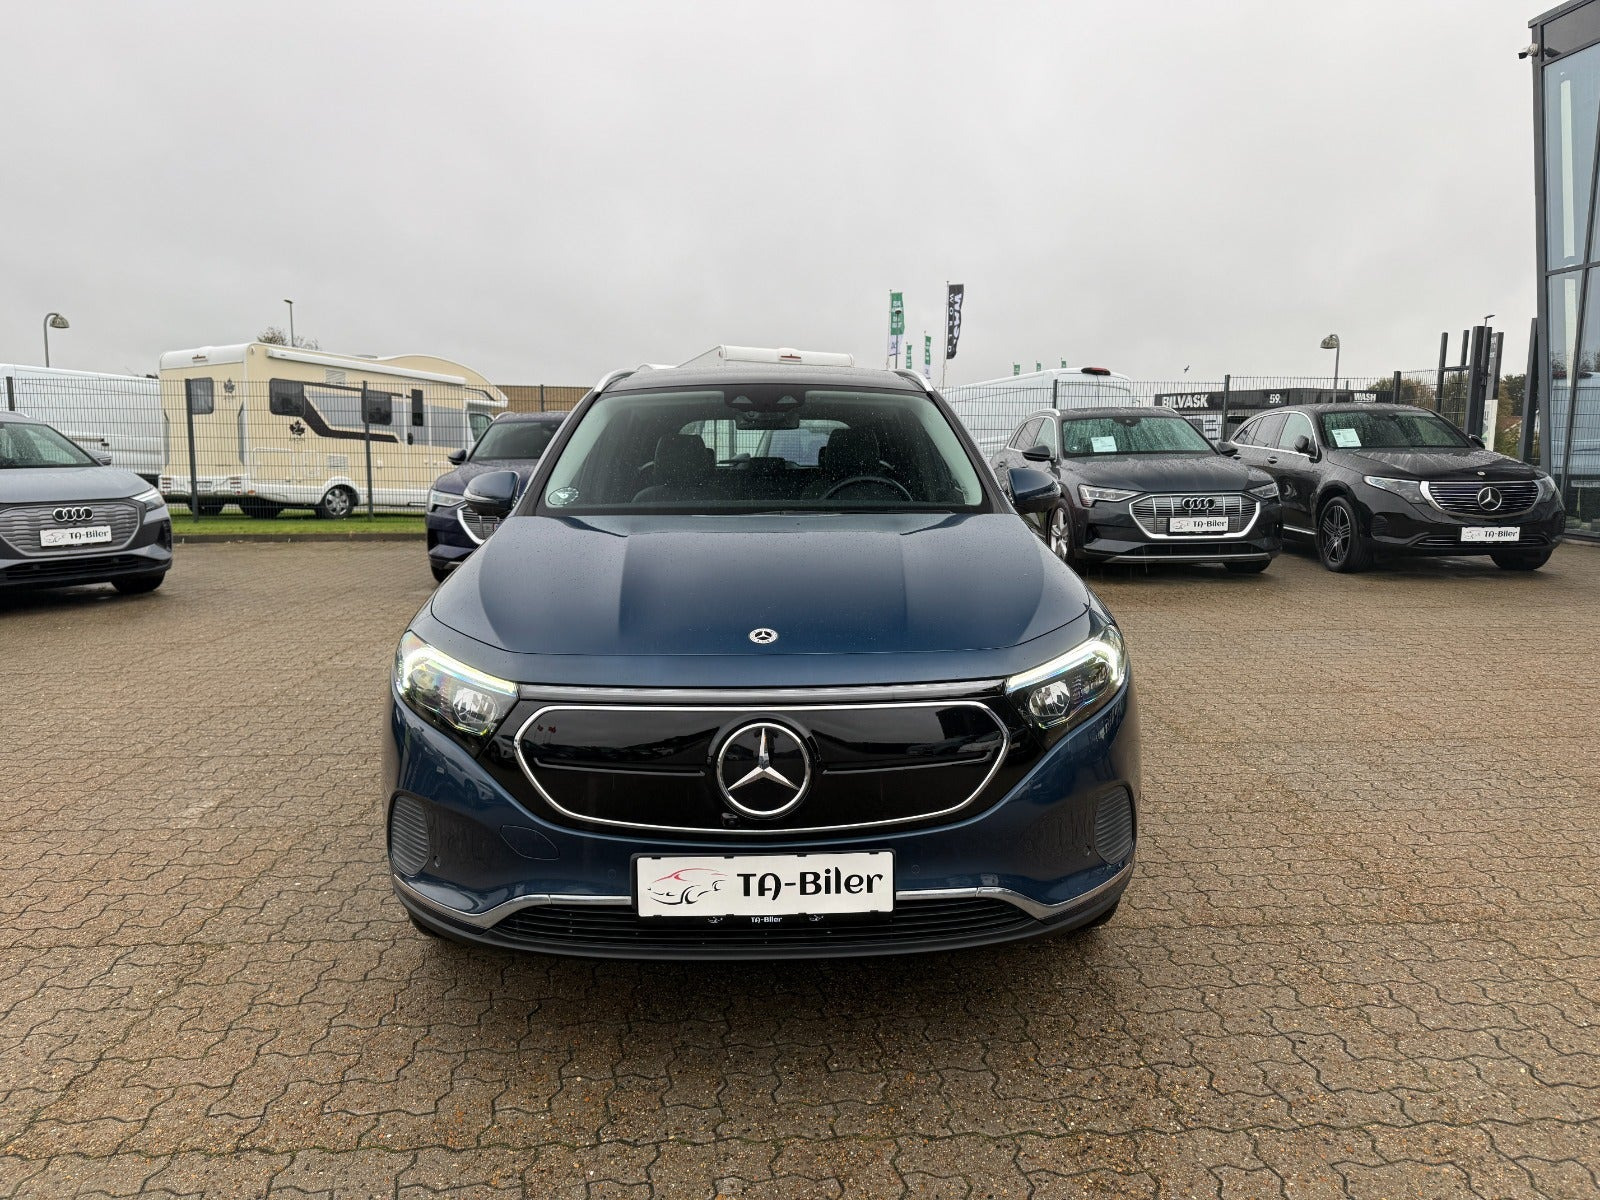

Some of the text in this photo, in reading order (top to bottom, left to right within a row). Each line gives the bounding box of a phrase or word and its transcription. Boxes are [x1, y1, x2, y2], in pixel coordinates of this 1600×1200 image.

[1162, 394, 1209, 409] BILVASK
[1353, 392, 1377, 402] WASH
[1192, 519, 1227, 528] TA-Biler
[68, 529, 109, 540] TA-Biler
[1483, 530, 1518, 538] TA-Biler
[736, 866, 884, 901] TA-Biler
[750, 916, 783, 924] TA-Biler
